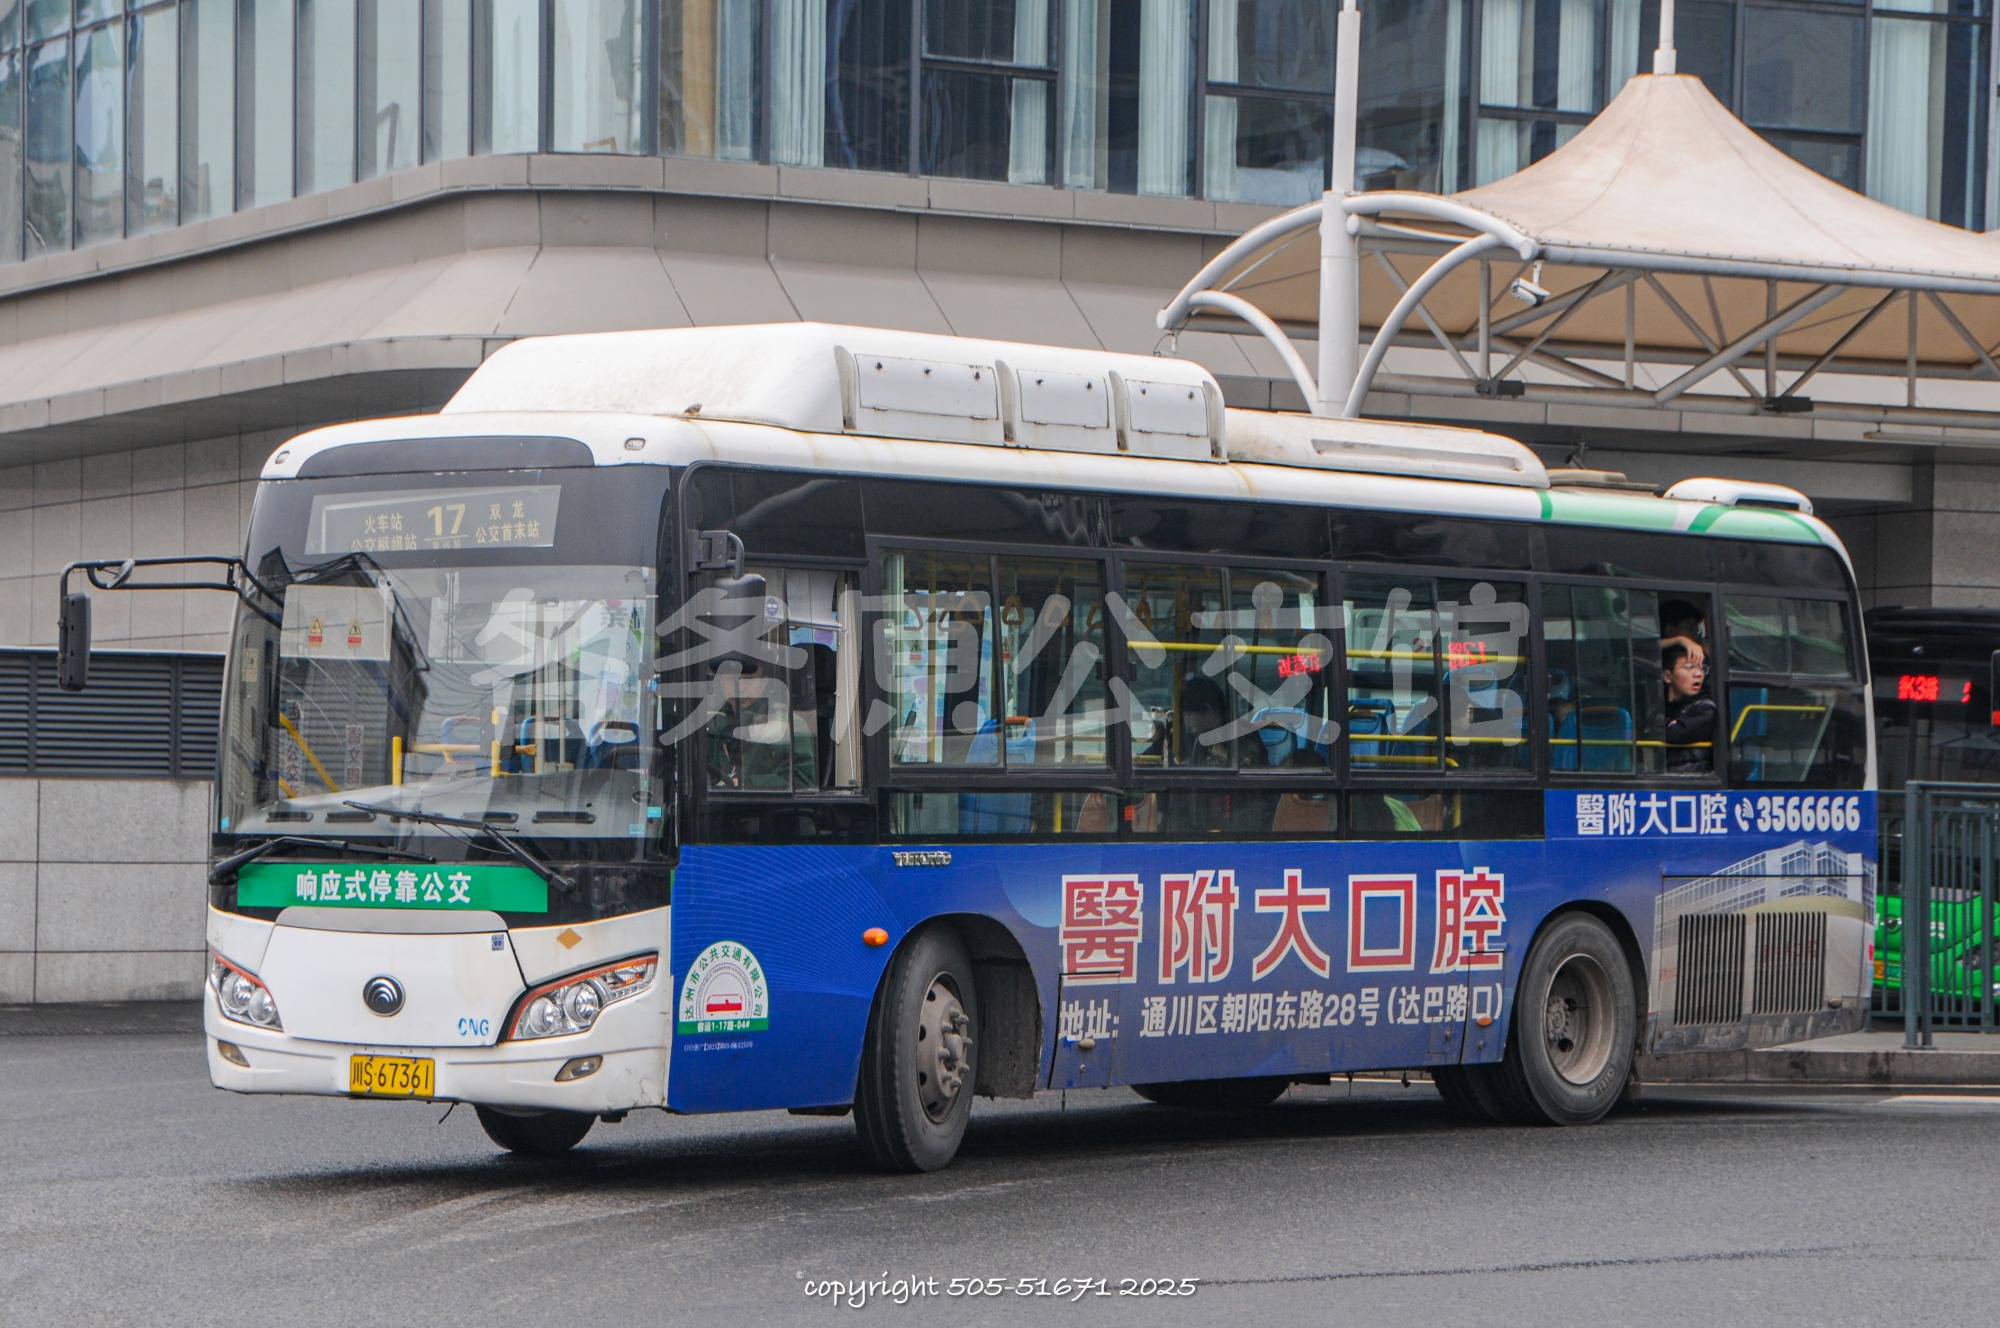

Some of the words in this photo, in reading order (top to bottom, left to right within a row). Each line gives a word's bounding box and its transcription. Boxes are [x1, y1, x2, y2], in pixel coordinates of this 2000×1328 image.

[365, 512, 403, 534] 火车站
[427, 503, 466, 536] 17
[475, 520, 540, 545] 公交首末站
[1576, 793, 1729, 836] 醫附大口腔
[1756, 796, 1861, 832] 3566666
[295, 871, 472, 904] 响应式停靠公交
[1059, 866, 1507, 987] 醫附大口腔
[458, 1016, 490, 1037] CNG
